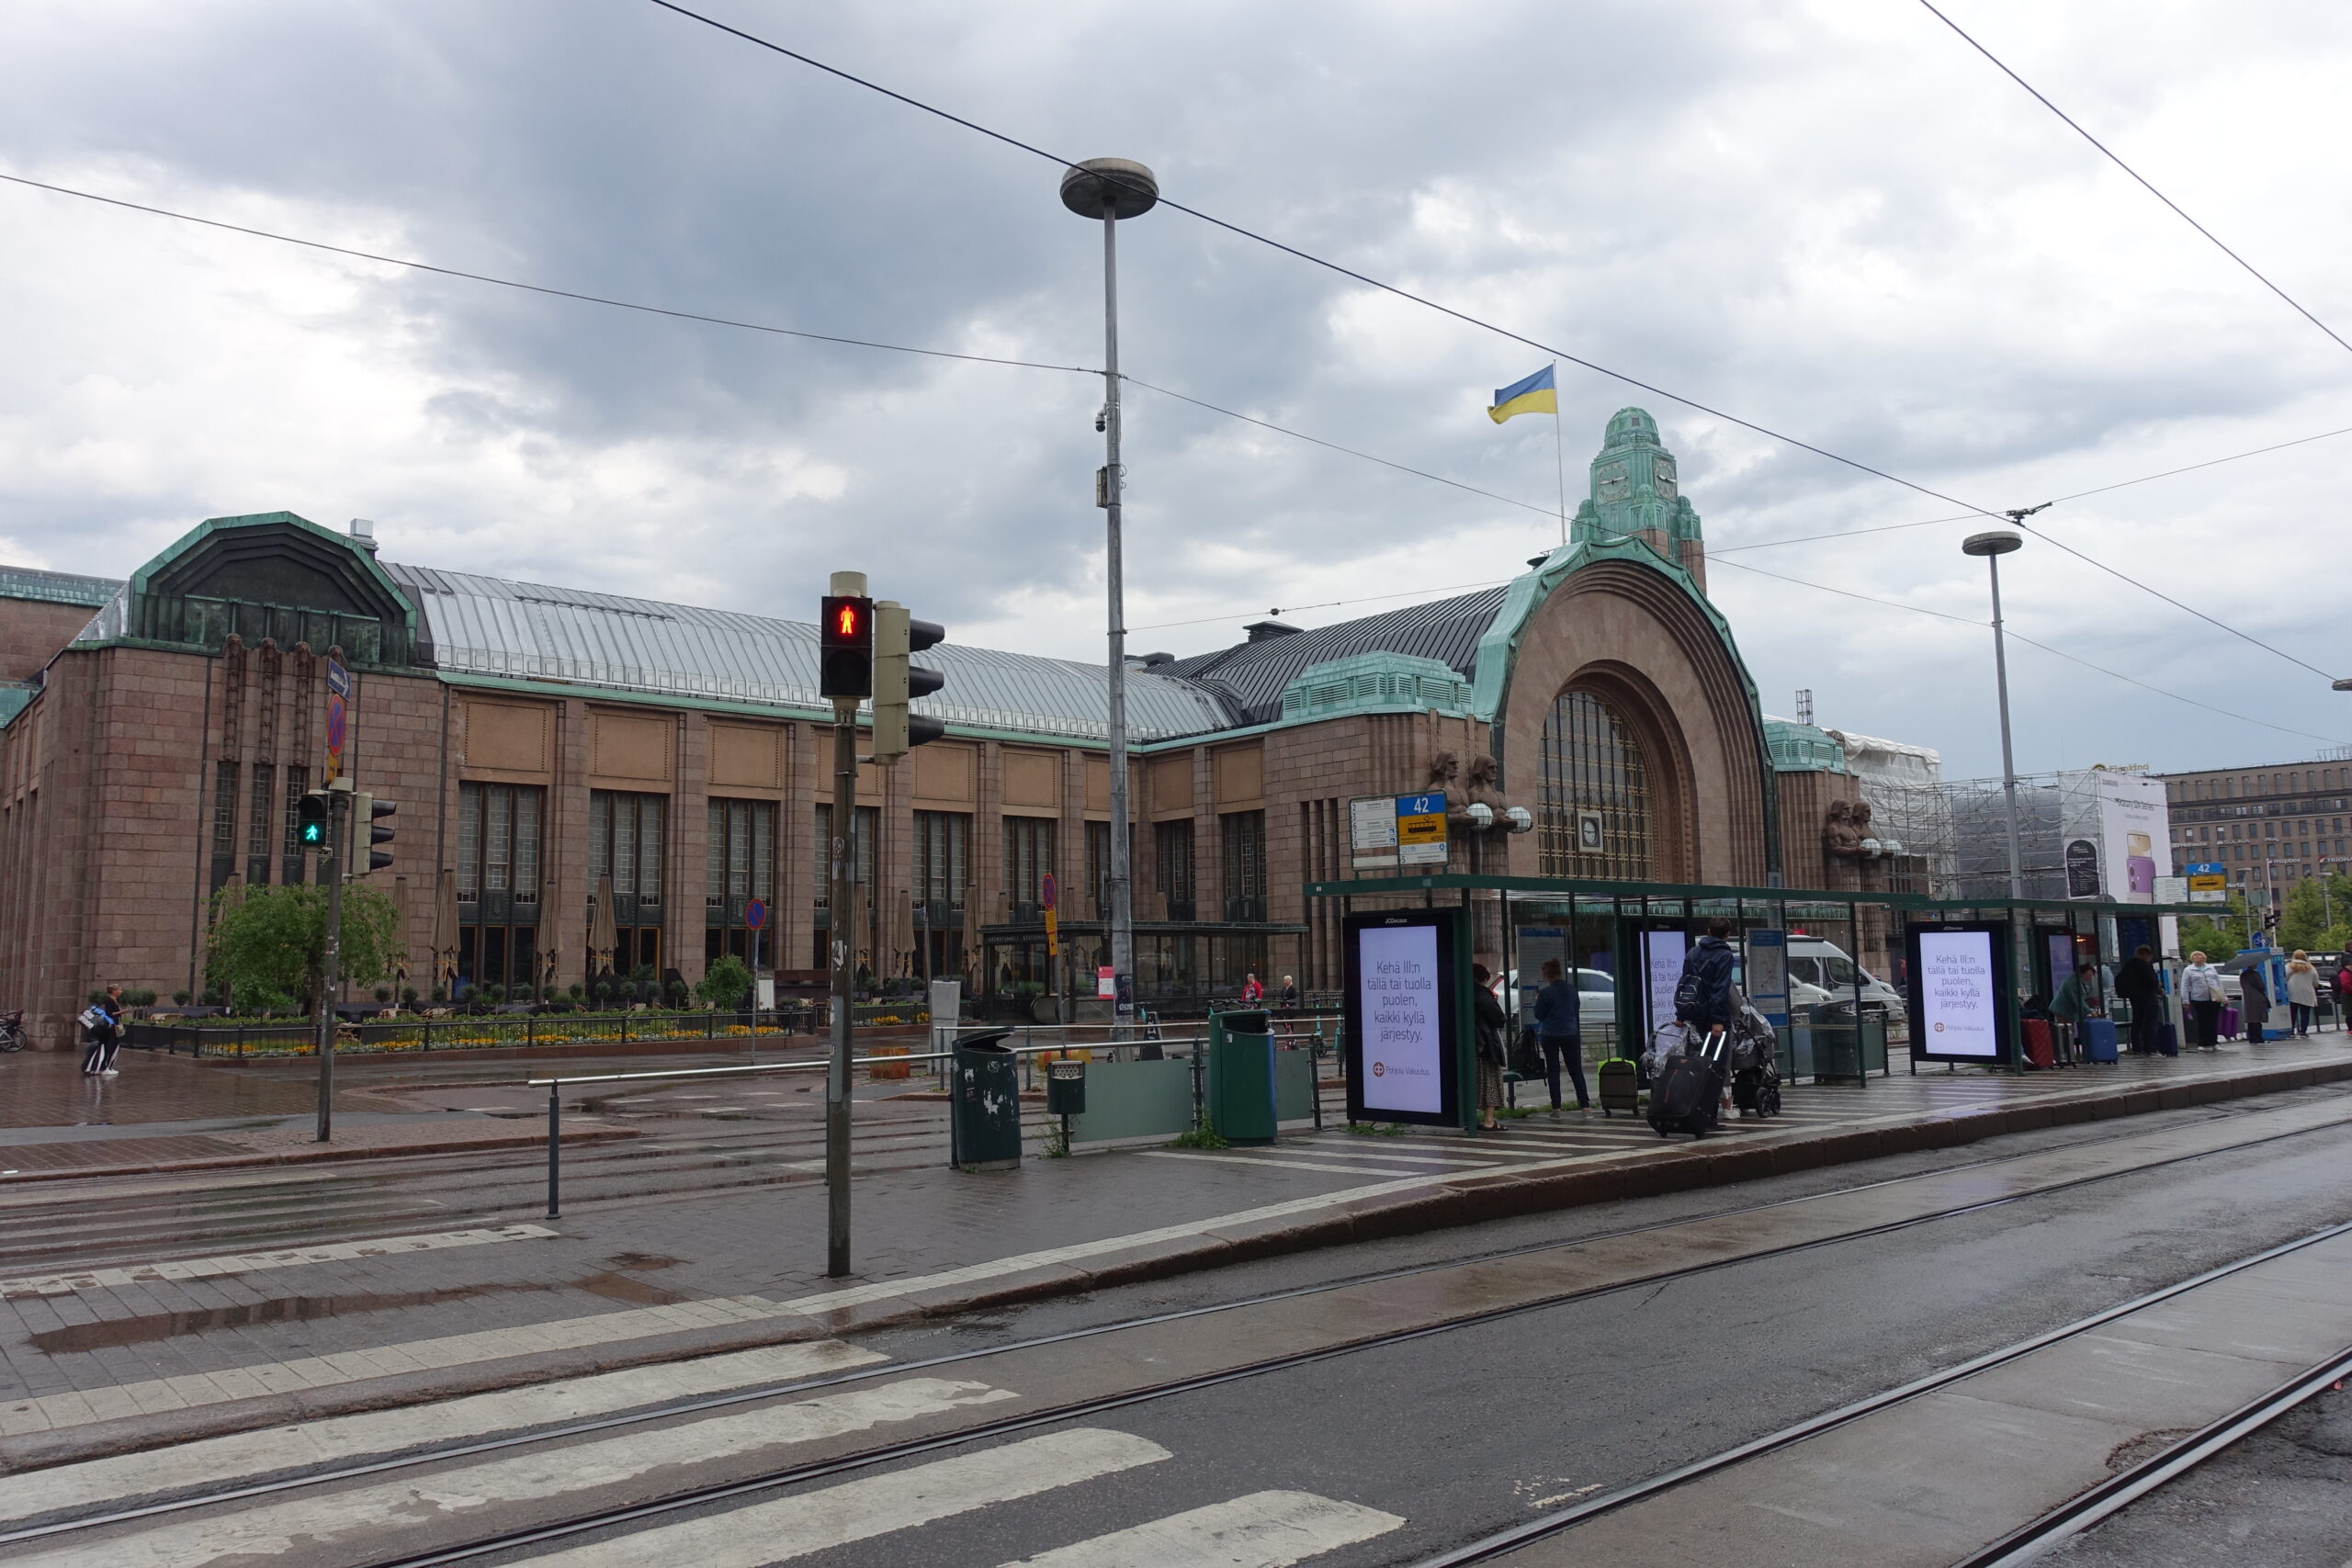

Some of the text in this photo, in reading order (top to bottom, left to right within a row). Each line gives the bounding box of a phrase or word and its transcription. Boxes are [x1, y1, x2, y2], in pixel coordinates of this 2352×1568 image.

[1414, 797, 1429, 813] 42
[2198, 863, 2211, 873] 42
[1936, 954, 1957, 964] Kehä
[1376, 961, 1400, 974] Kehä
[1928, 966, 1985, 975] tällä tai tuolla
[1658, 972, 1667, 982] tai
[1941, 976, 1973, 987] puolen,
[1367, 977, 1431, 990] tällä tai tuolla
[1934, 988, 1980, 999] kaikki kyllä
[1383, 993, 1418, 1008] puolen,
[1653, 998, 1667, 1009] aikki
[1940, 999, 1979, 1010] järjestyy.
[1374, 1010, 1425, 1027] kaikki kyllä
[1380, 1027, 1422, 1043] järjestyy.
[1385, 1066, 1430, 1077] Pohjola Vakuutus
